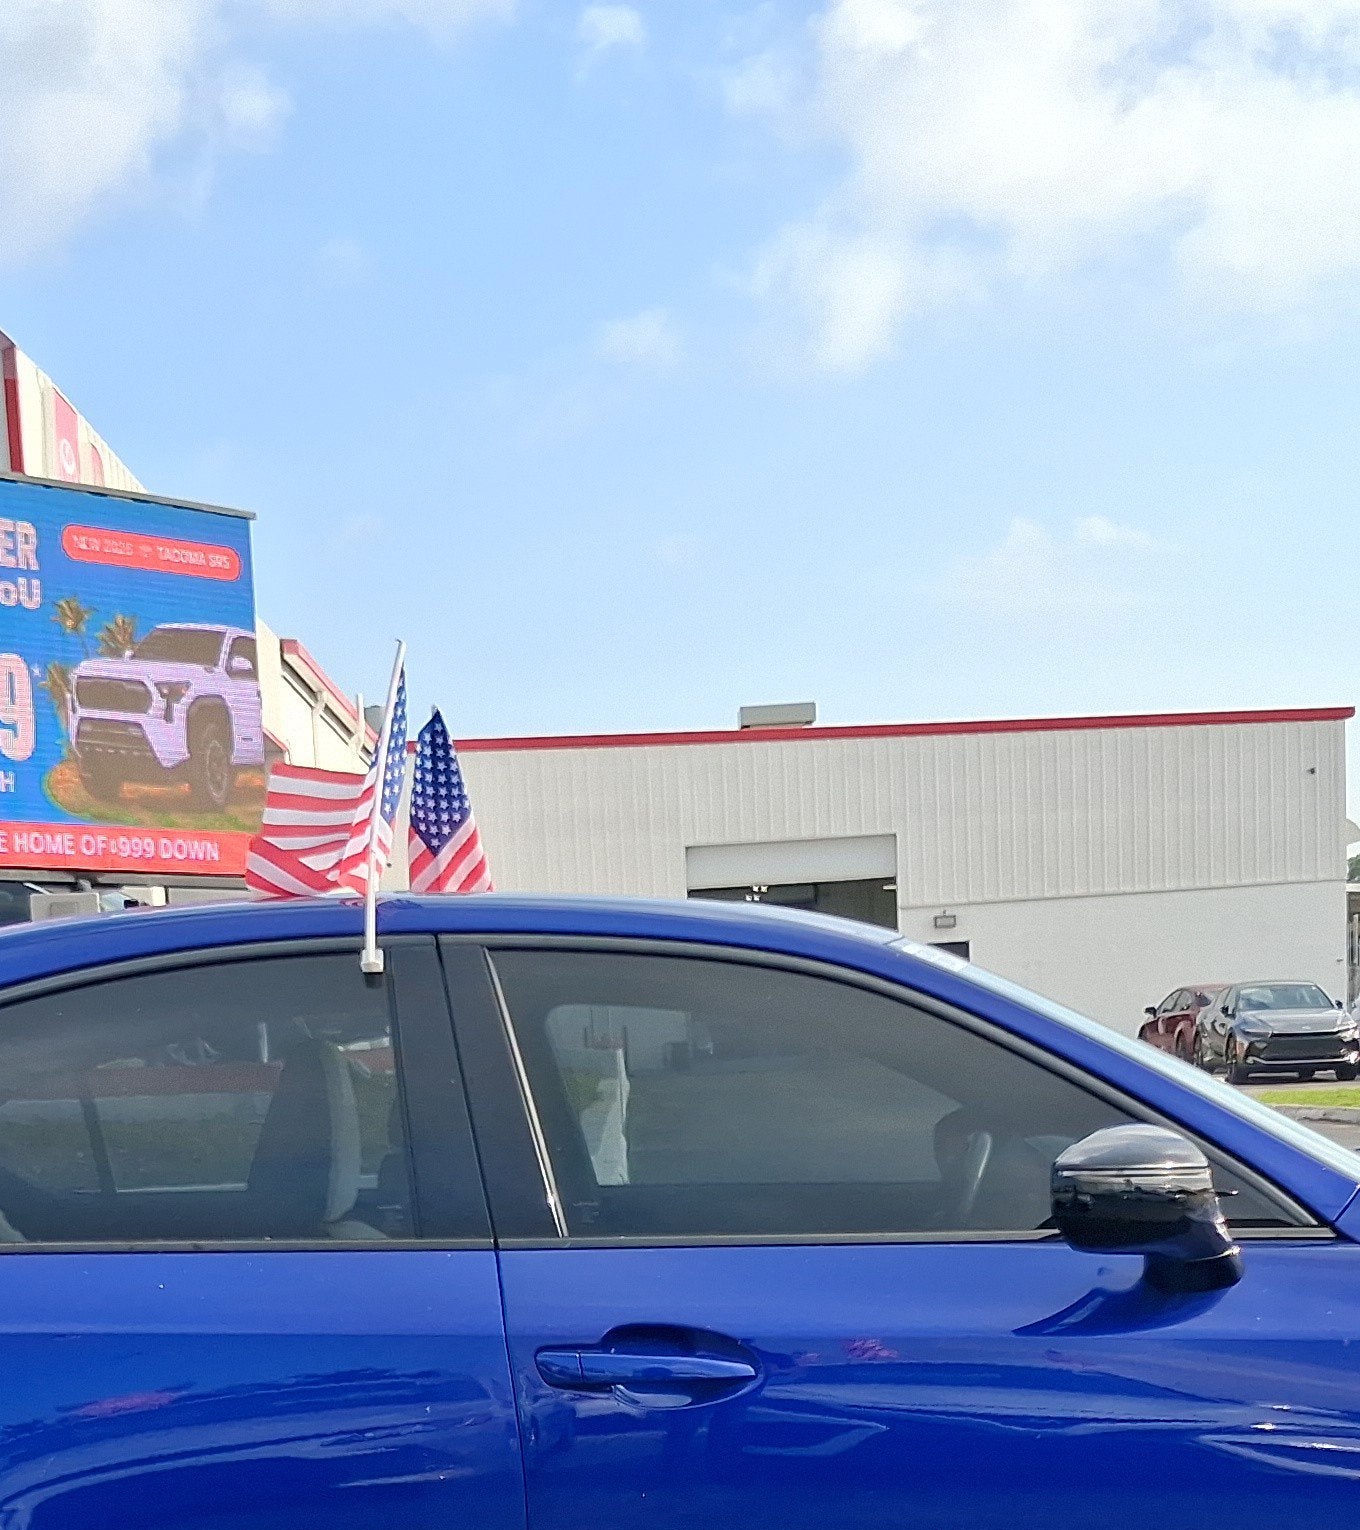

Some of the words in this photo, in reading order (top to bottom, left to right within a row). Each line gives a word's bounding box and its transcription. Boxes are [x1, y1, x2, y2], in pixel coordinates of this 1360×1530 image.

[13, 832, 75, 856] HOME
[81, 835, 108, 857] OF
[159, 837, 220, 862] DOWN
